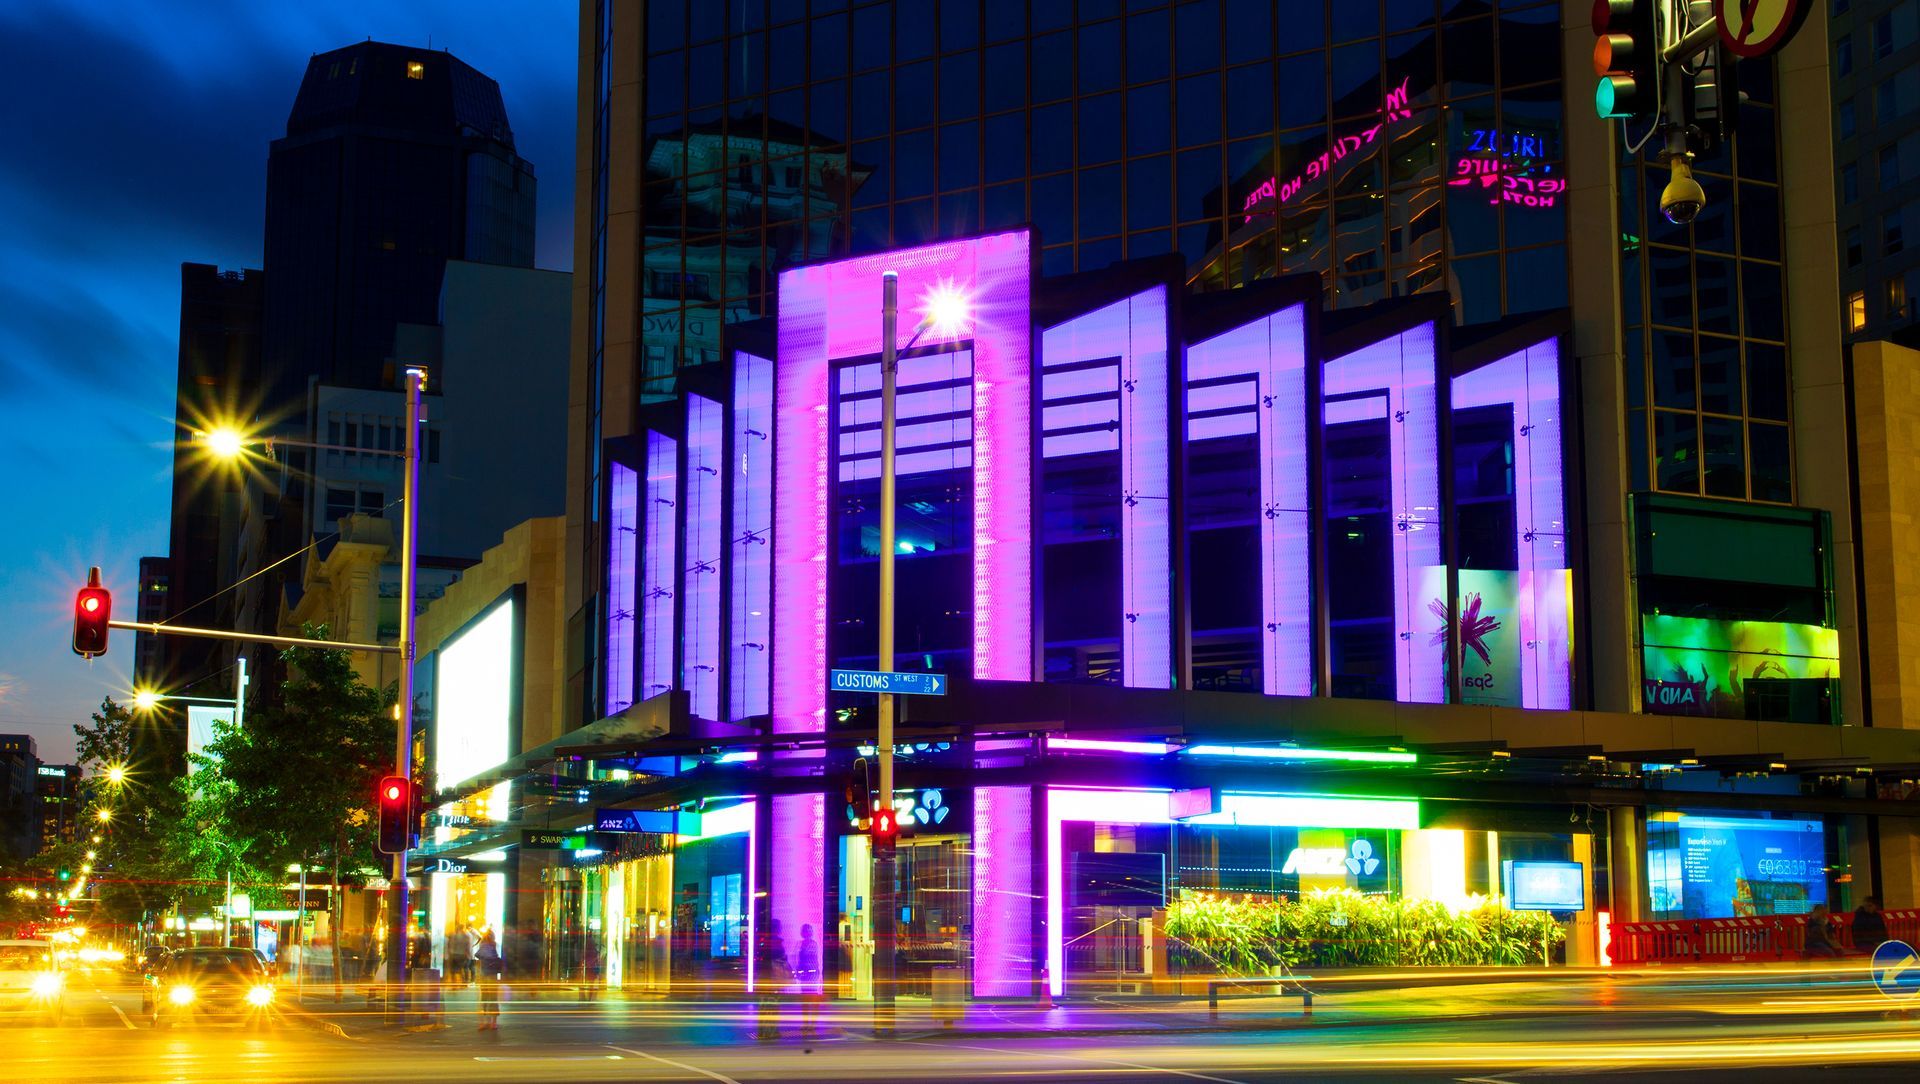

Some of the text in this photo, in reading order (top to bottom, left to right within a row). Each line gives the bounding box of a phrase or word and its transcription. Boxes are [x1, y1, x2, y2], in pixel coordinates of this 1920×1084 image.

[837, 673, 889, 689] CUSTOMS
[903, 675, 918, 683] WEST
[600, 820, 623, 829] ANZ
[437, 858, 467, 873] Dior
